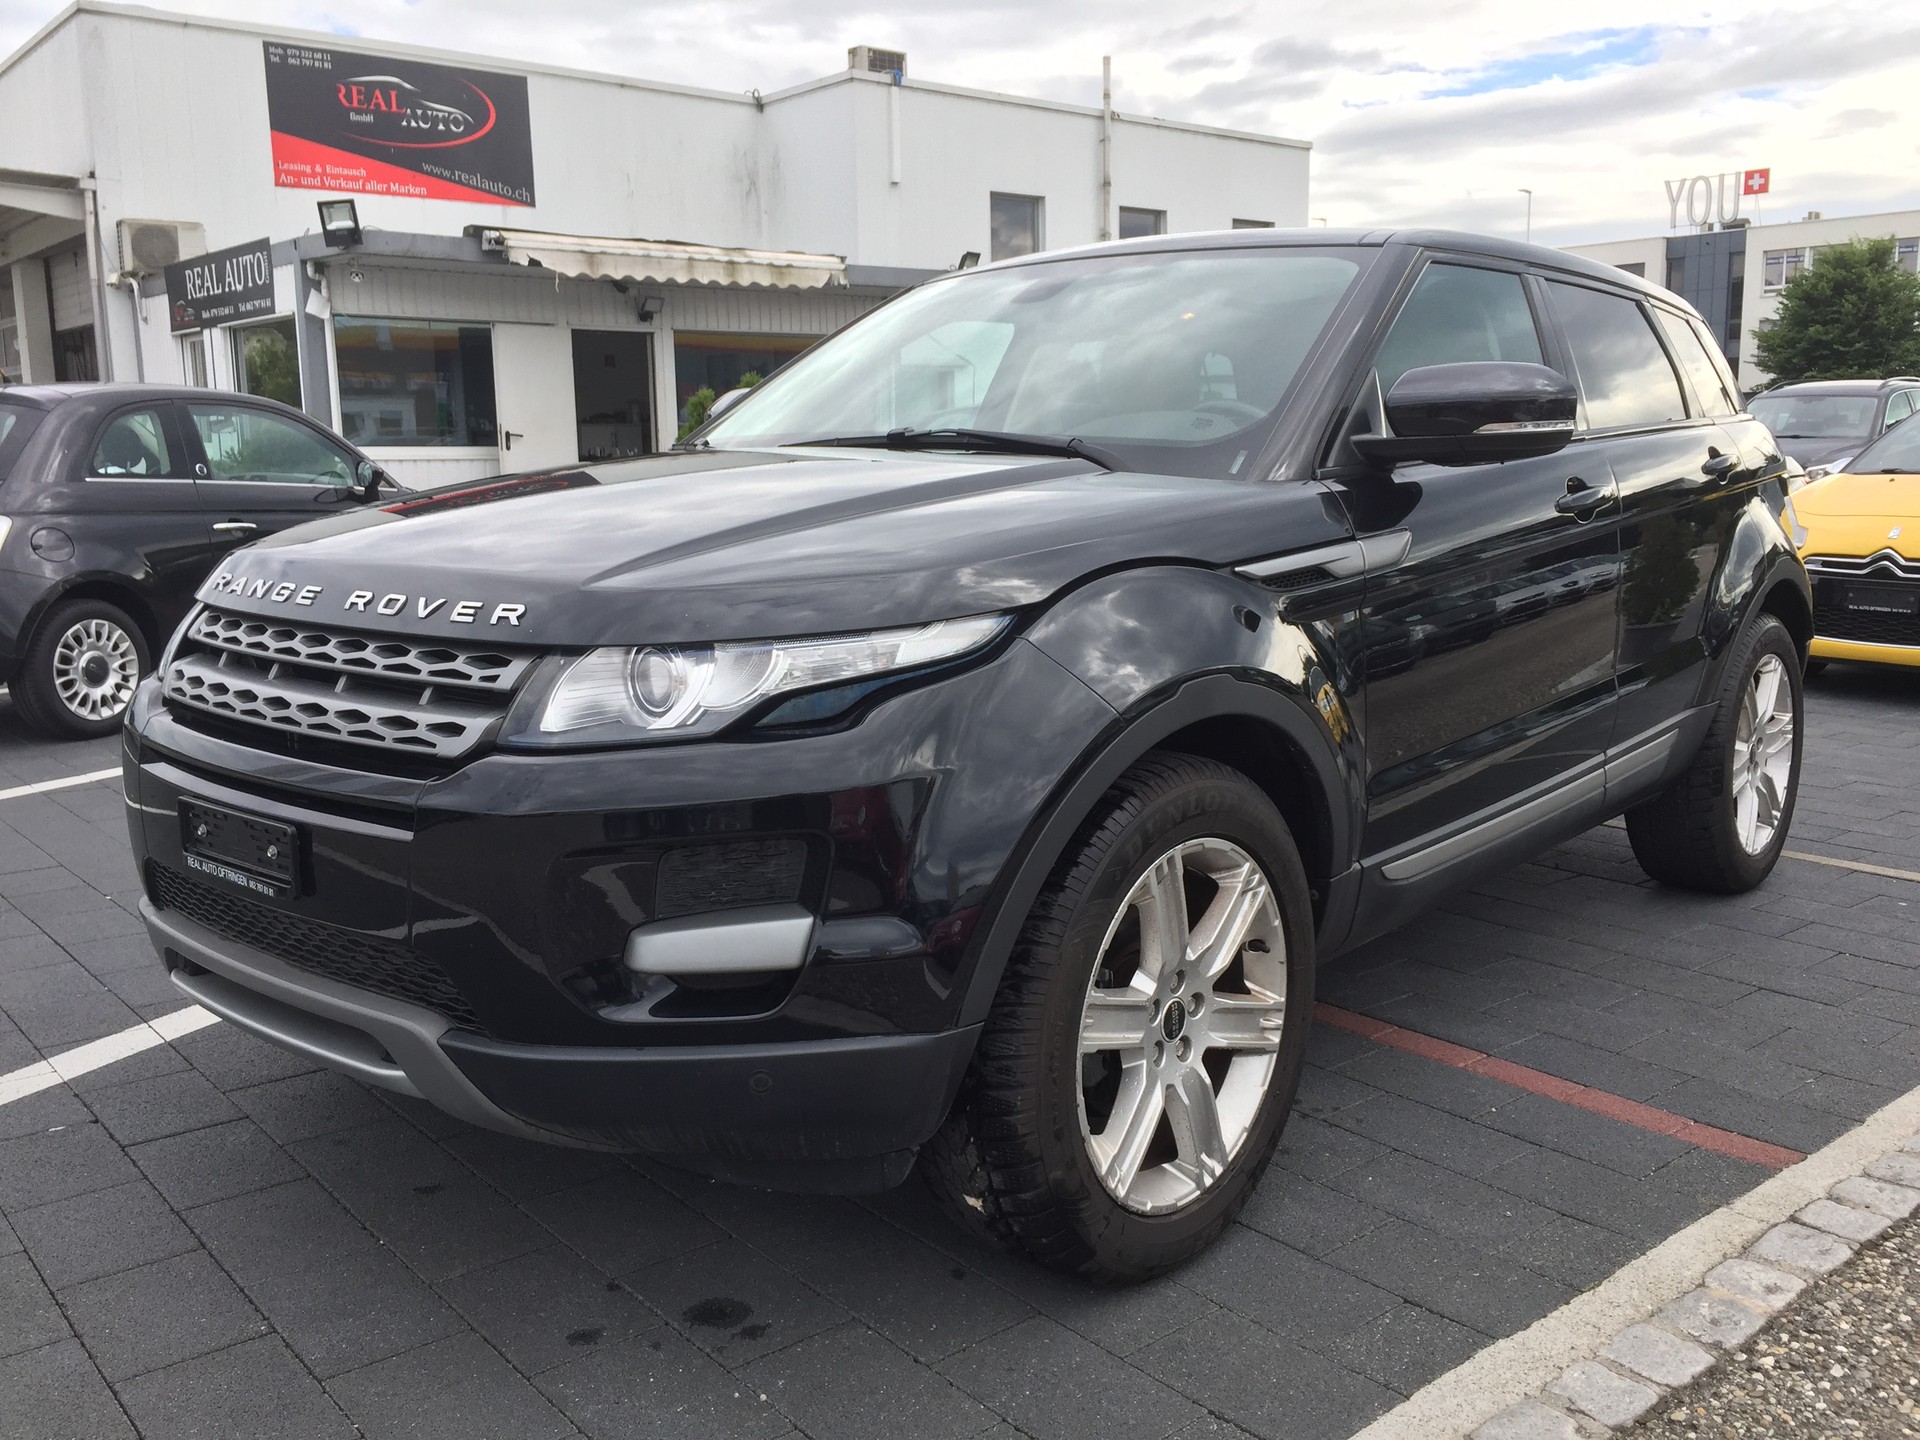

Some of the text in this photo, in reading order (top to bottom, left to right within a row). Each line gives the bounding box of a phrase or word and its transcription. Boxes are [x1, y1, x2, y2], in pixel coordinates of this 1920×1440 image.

[335, 83, 465, 133] REAL AUTO
[349, 111, 374, 123] GmbH
[278, 160, 367, 177] Leasing & Eintausch
[279, 174, 427, 195] An- und Verkauf aller Marken
[421, 161, 531, 203] www.realauto.ch
[1664, 171, 1741, 229] YOU
[184, 263, 222, 300] REAL
[225, 251, 265, 292] AUTO
[212, 571, 527, 626] RANGE ROVER
[187, 856, 202, 870] REAL
[202, 862, 218, 876] AUTO
[217, 866, 248, 887] OFTRINGEN
